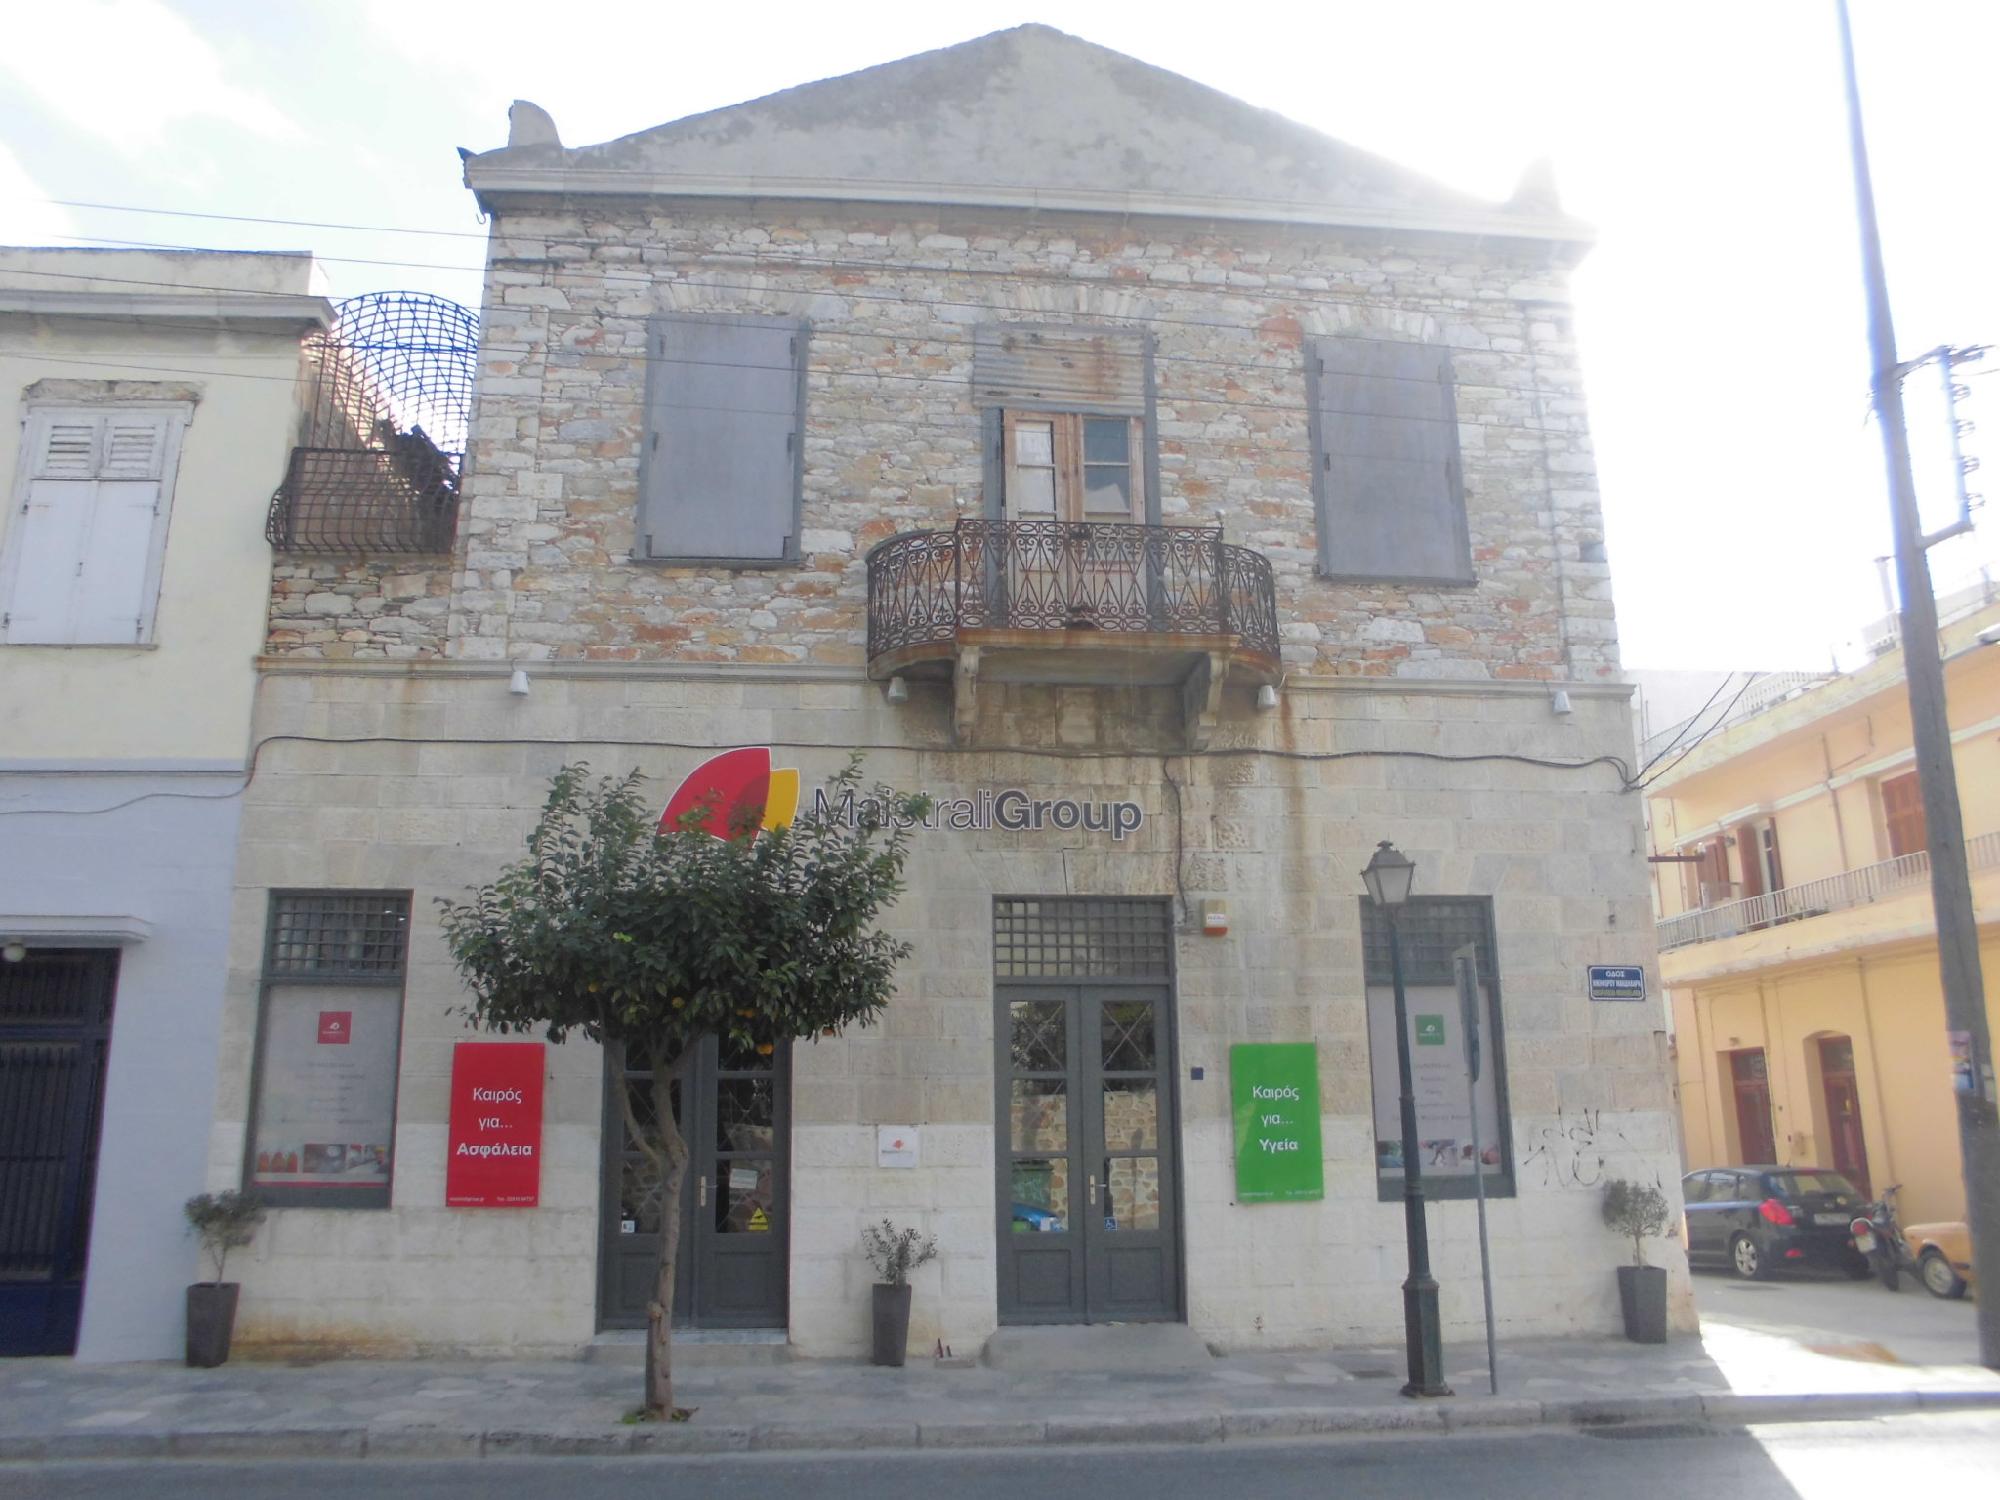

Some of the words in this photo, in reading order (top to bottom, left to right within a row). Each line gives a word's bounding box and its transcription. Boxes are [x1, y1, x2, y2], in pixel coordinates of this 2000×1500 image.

[1605, 970, 1625, 978] ΟΔΟΣ
[473, 1087, 522, 1104] Καιρός
[1252, 1086, 1300, 1101] Καιρός
[478, 1116, 513, 1131] για...
[1261, 1114, 1294, 1128] για...
[456, 1142, 532, 1158] Ασφάλεια
[1259, 1138, 1299, 1154] Υγεία
